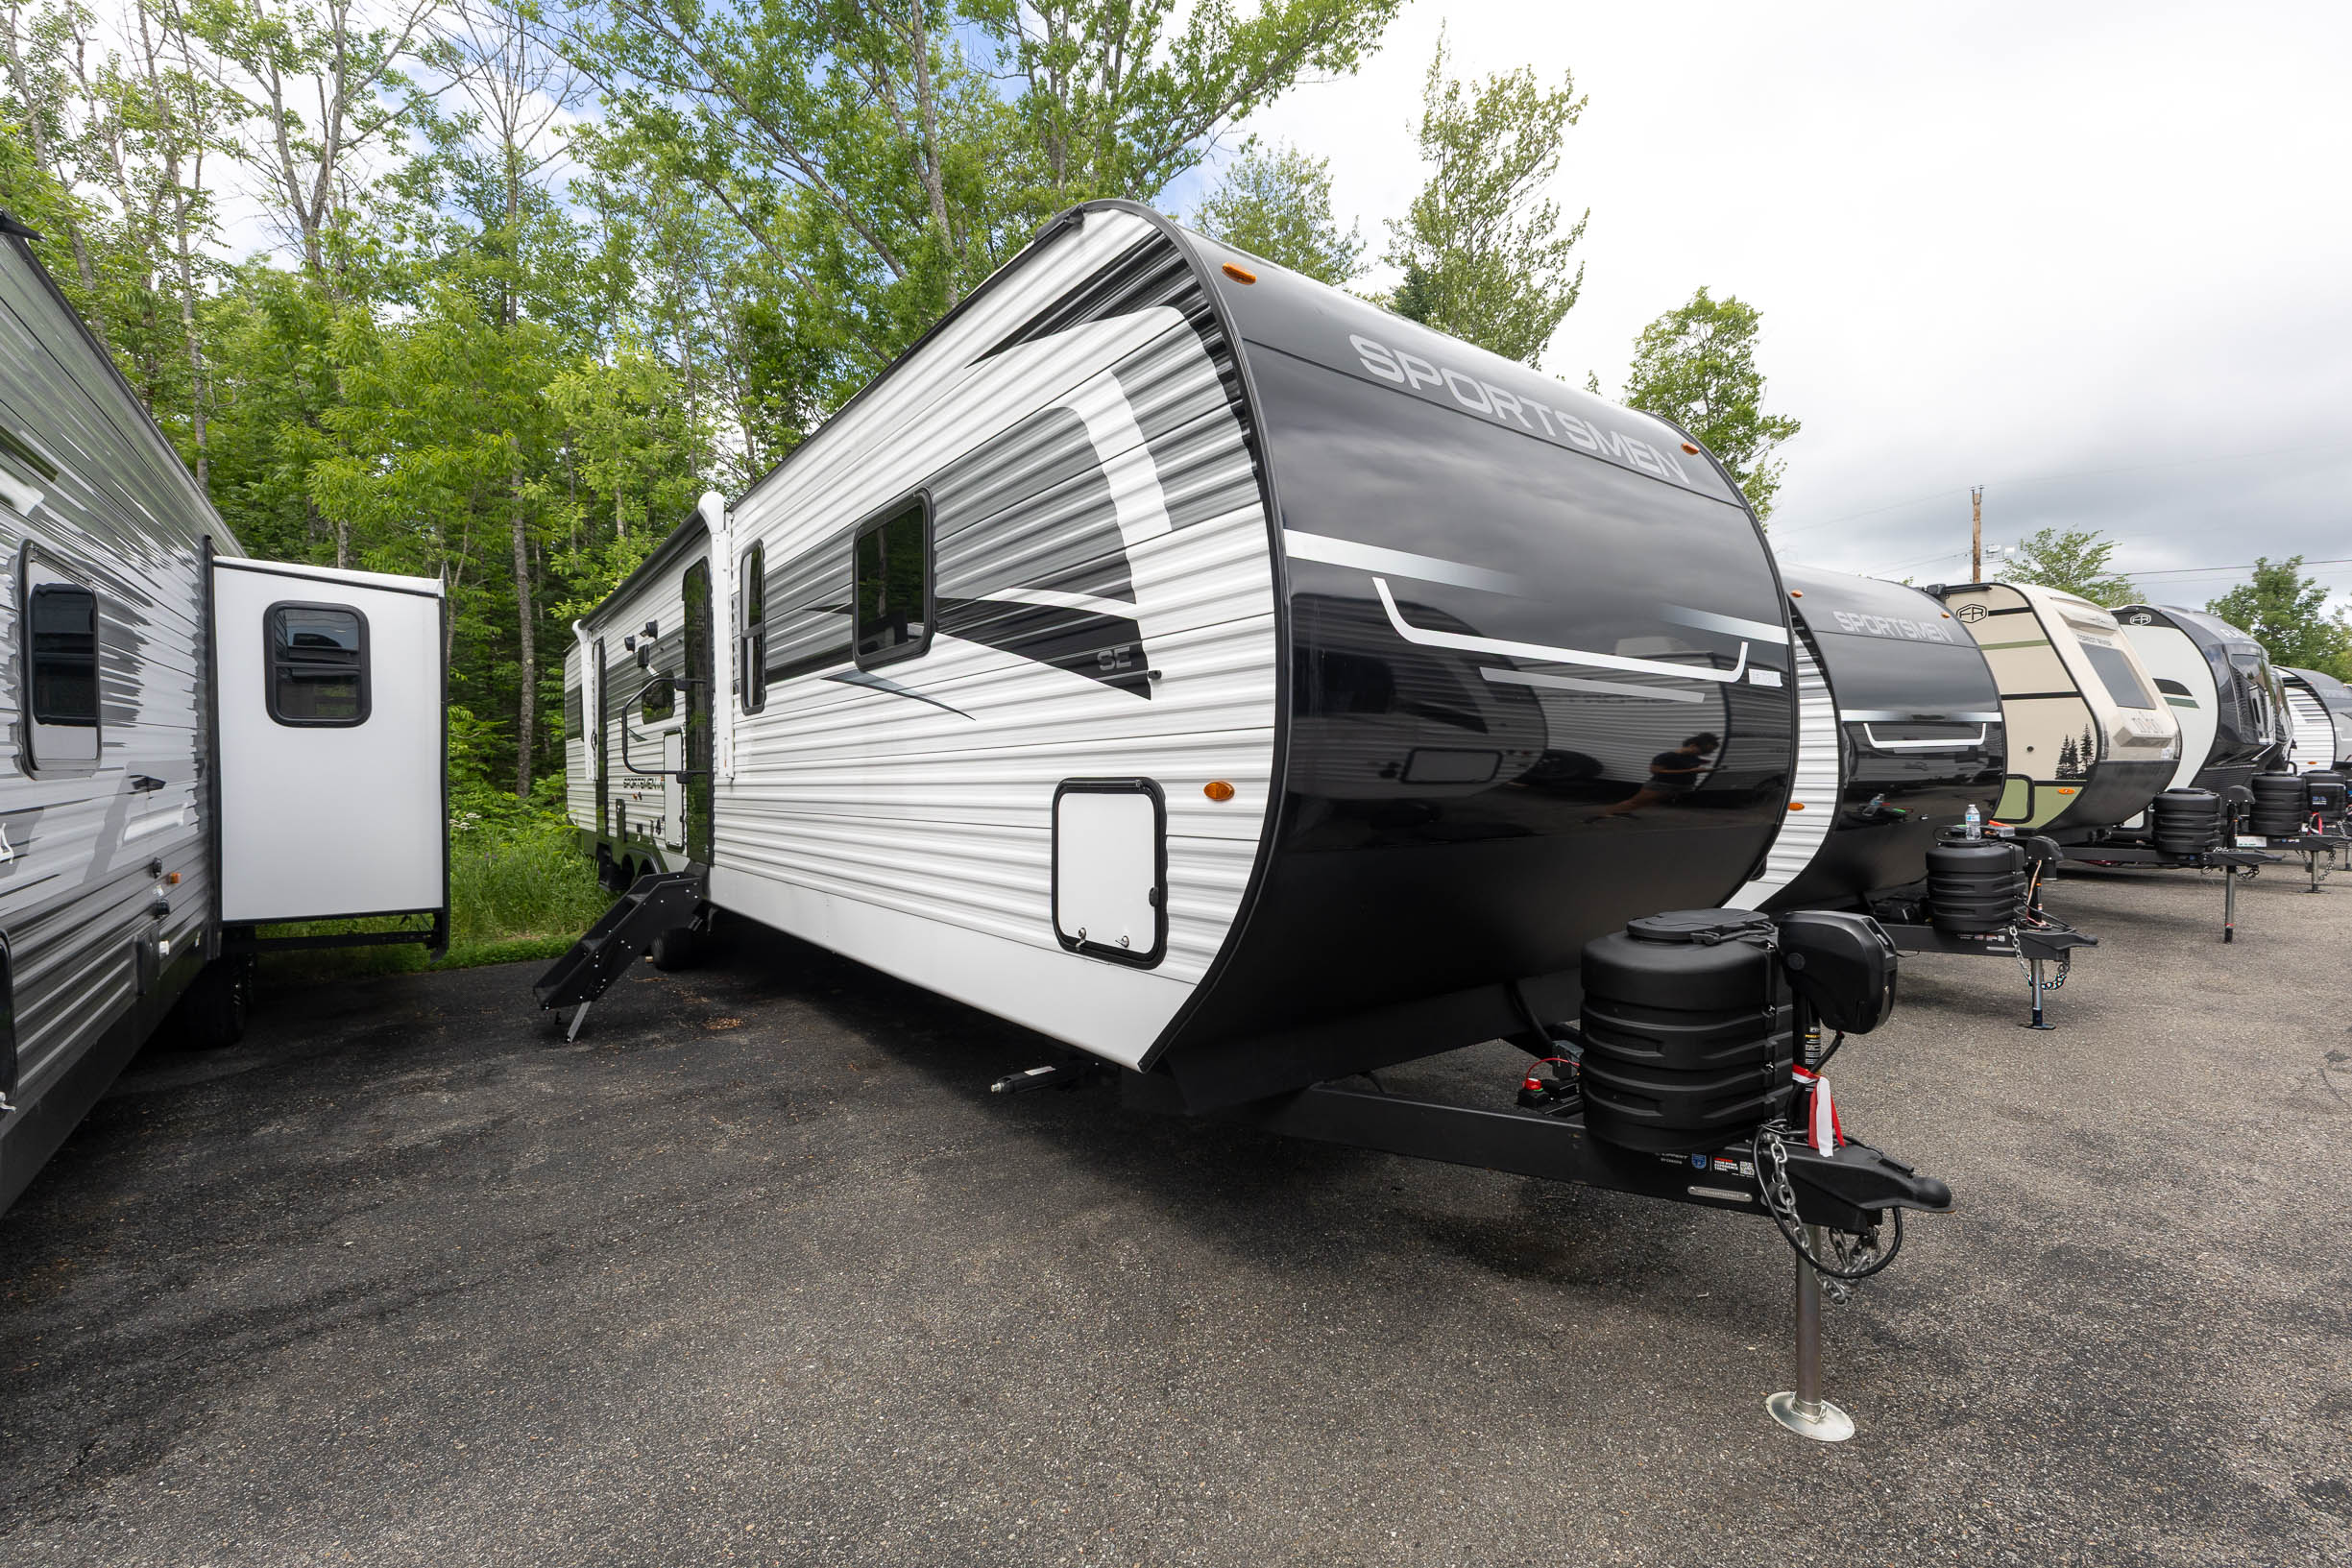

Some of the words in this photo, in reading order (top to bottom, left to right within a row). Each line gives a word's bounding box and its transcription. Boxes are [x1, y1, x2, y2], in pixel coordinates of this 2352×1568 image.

[1348, 333, 1691, 485] SPORTSMEN
[1832, 611, 1954, 642] SPORTSMEN
[1958, 605, 1985, 621] FR
[1097, 646, 1131, 670] SE
